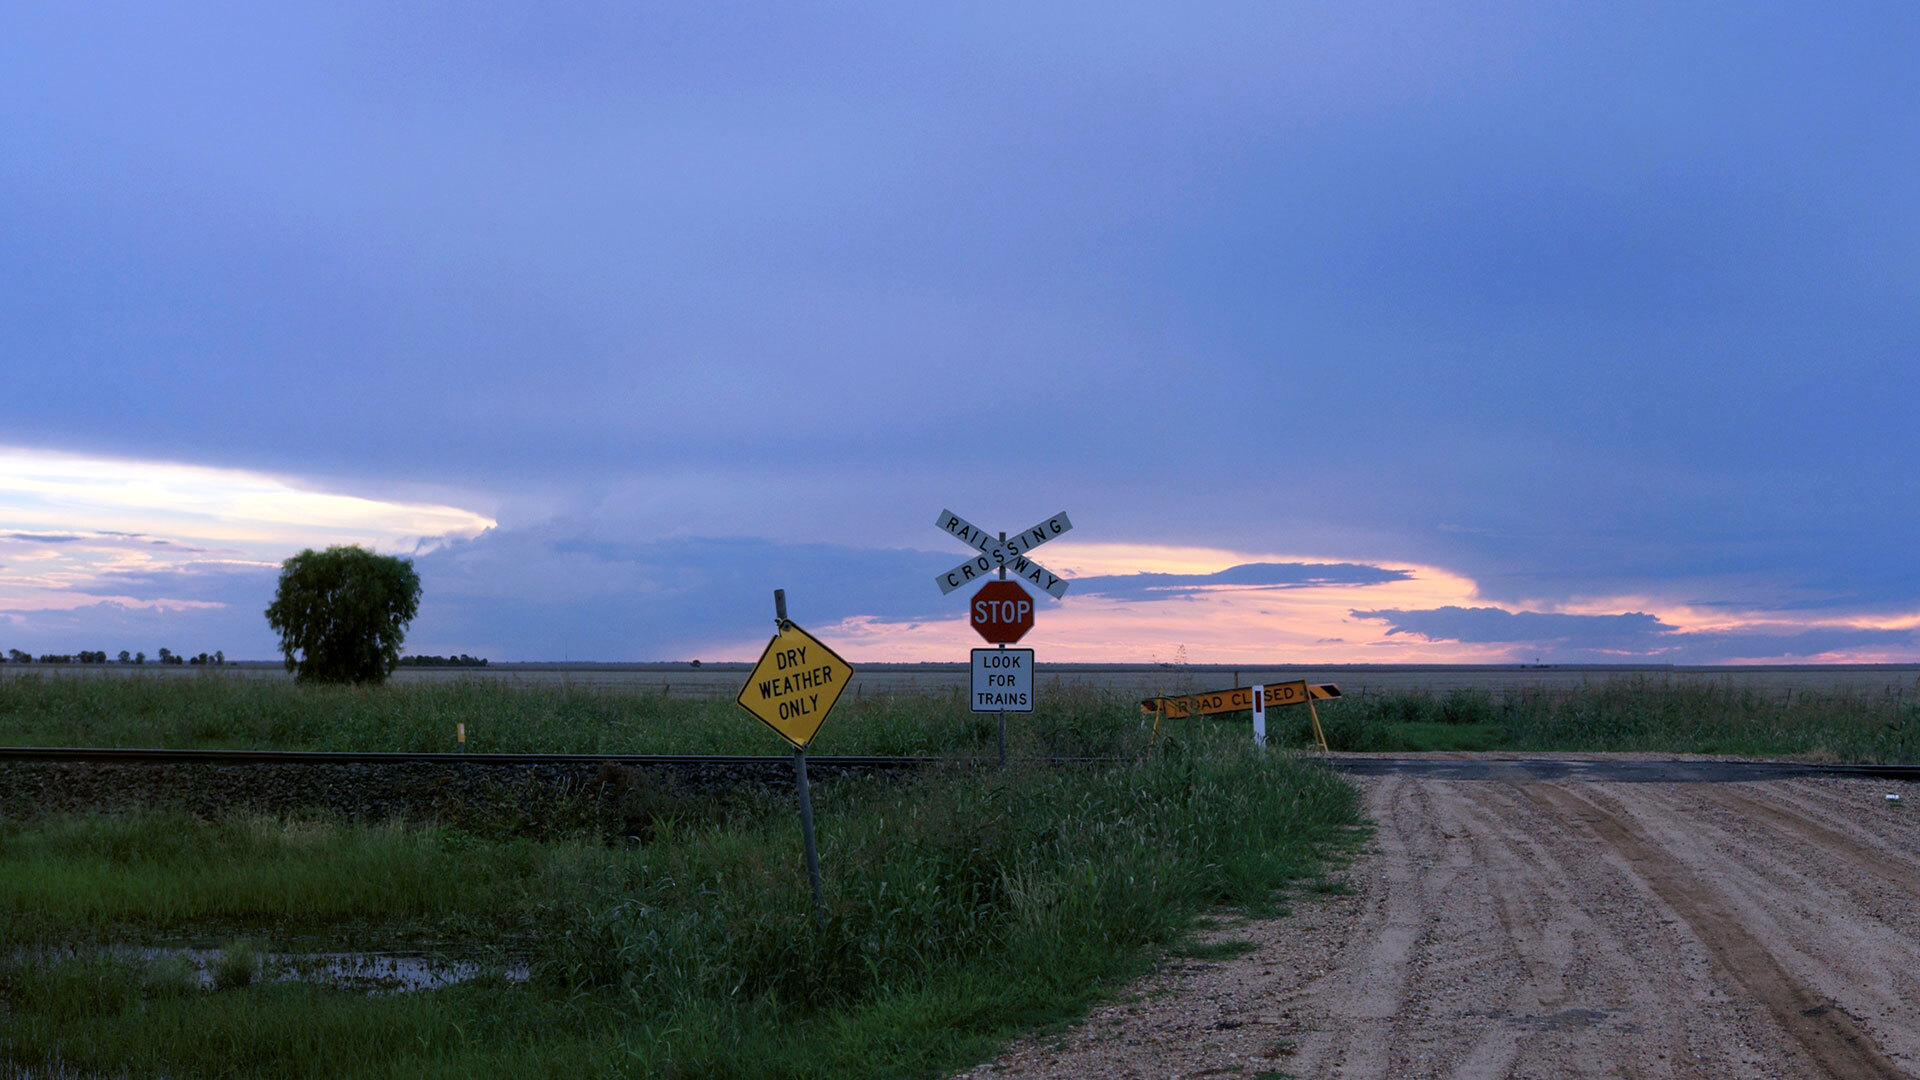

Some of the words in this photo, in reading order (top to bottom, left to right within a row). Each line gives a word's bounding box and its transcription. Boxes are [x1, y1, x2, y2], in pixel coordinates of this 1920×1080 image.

[946, 516, 989, 555] RAIL
[1015, 556, 1059, 590] WAY
[947, 519, 1062, 587] CROSSING
[974, 600, 1030, 624] STOP
[776, 646, 806, 670] DRY
[983, 656, 1020, 668] LOOK
[759, 665, 833, 700] WEATHER
[988, 675, 1016, 687] FOR
[779, 694, 818, 720] ONLY
[977, 692, 1027, 705] TRAINS
[1231, 687, 1294, 706] CLSED
